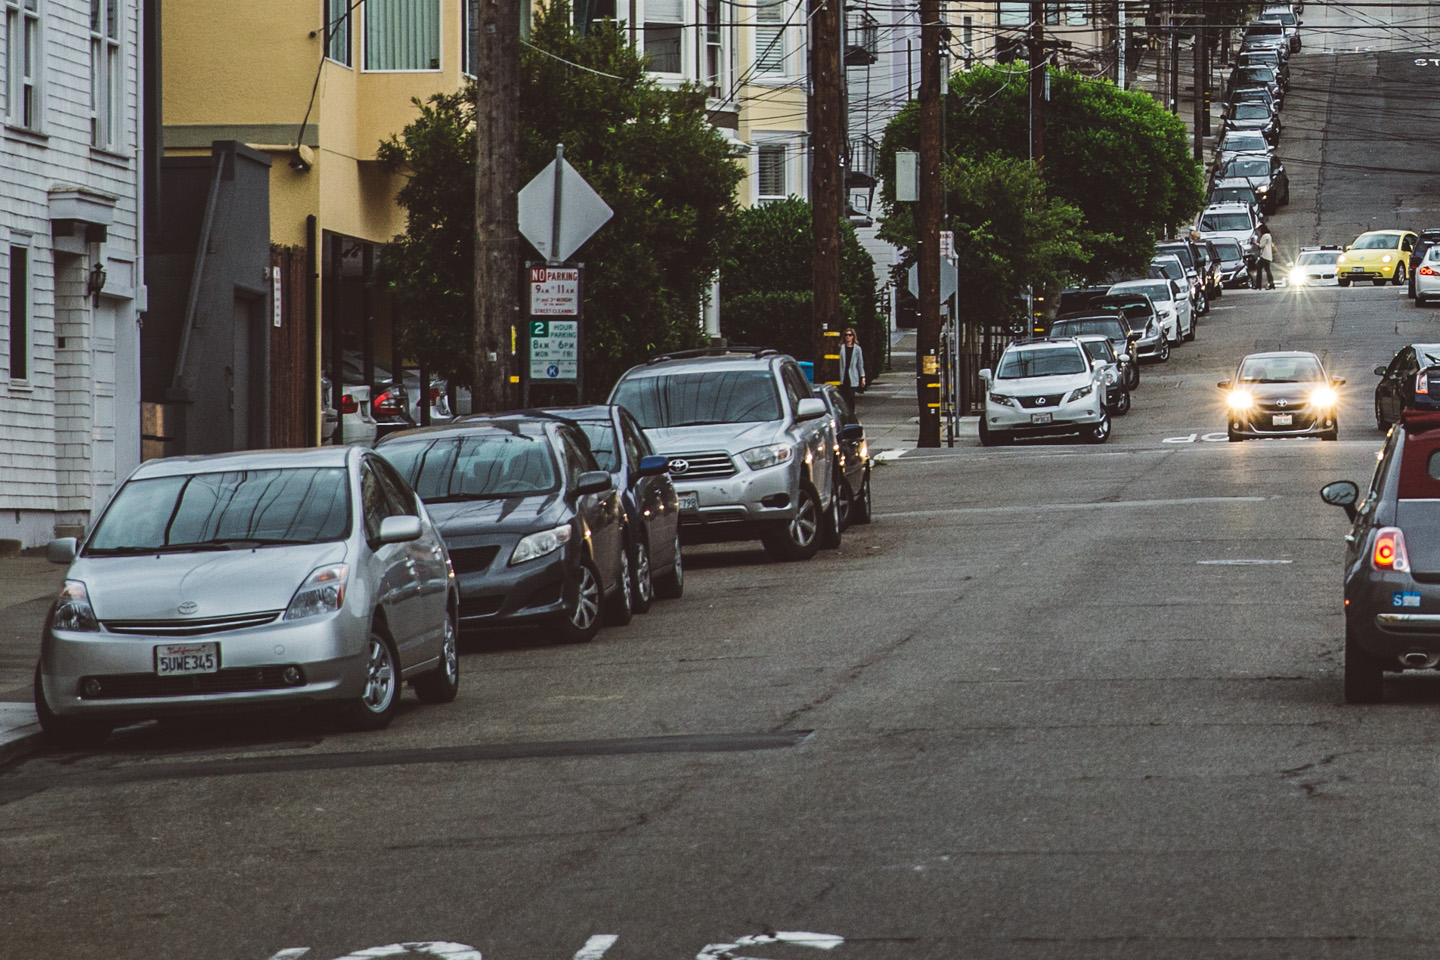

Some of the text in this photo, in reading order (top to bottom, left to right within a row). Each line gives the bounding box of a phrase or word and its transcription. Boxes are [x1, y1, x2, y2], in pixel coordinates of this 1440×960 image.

[532, 269, 578, 281] NO PARKING
[534, 322, 545, 334] 2
[1393, 594, 1402, 606] S
[160, 654, 214, 671] 5UWE345
